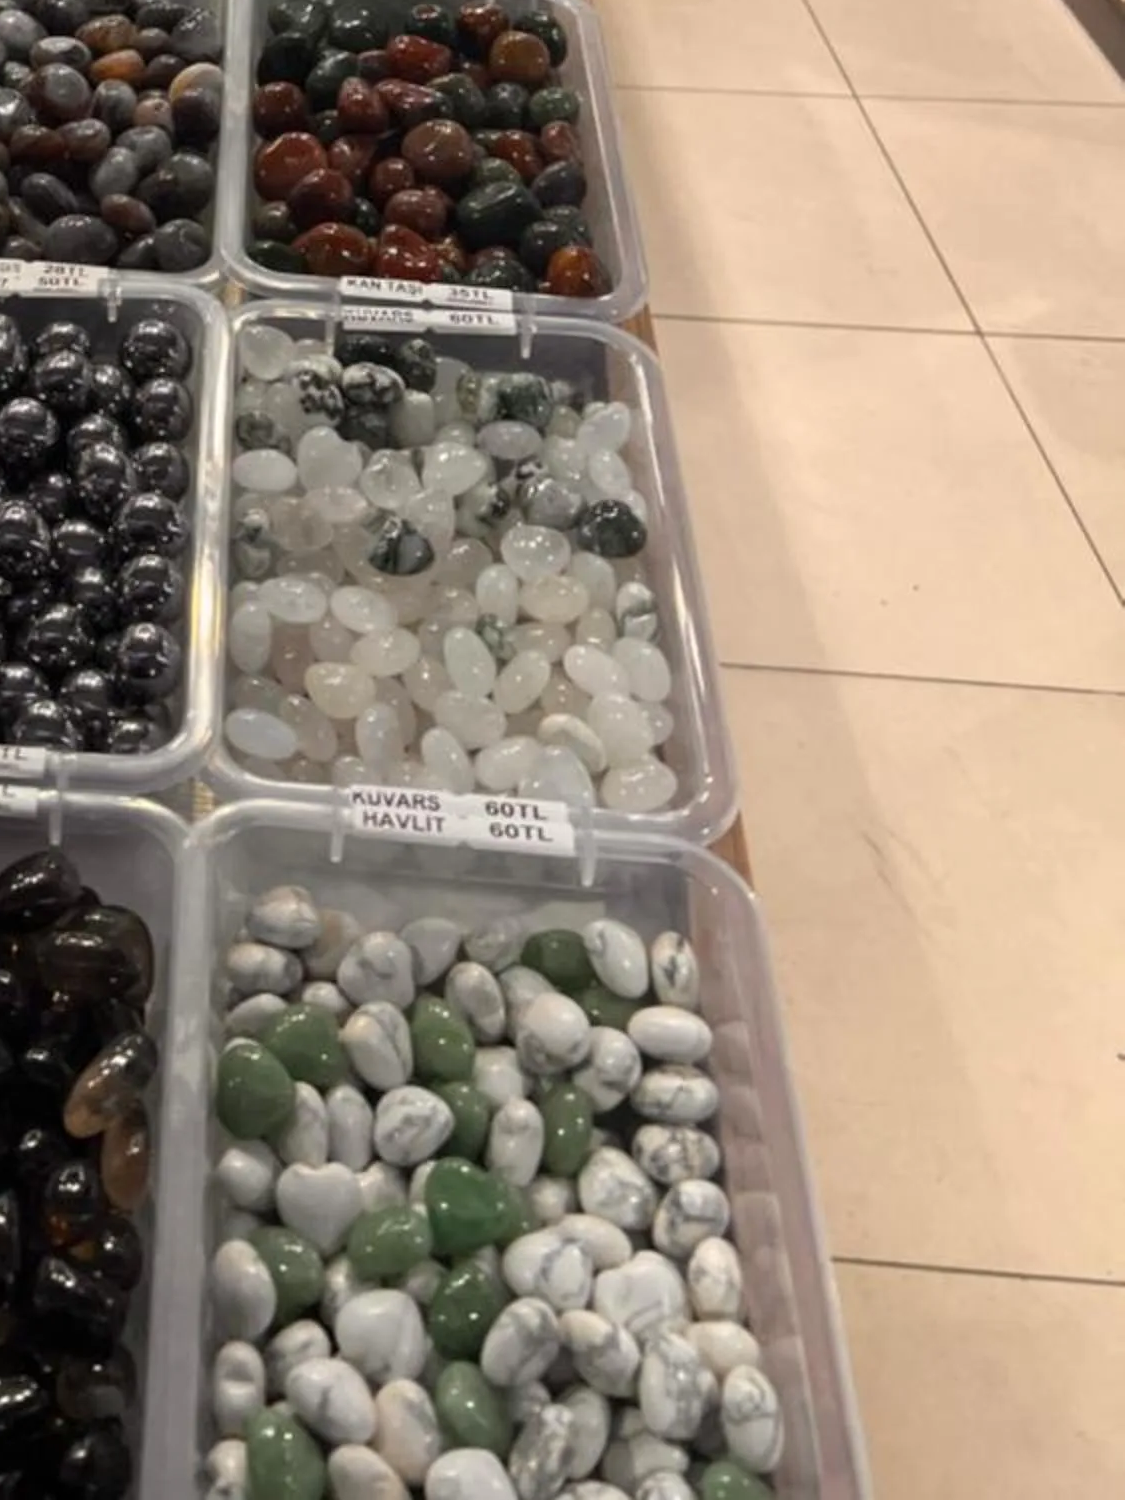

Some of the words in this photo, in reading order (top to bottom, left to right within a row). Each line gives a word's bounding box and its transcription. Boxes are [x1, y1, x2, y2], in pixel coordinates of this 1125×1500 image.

[346, 278, 381, 290] KAN
[352, 791, 442, 812] KUVARS
[485, 800, 549, 821] 60TL
[489, 822, 554, 842] 60TL
